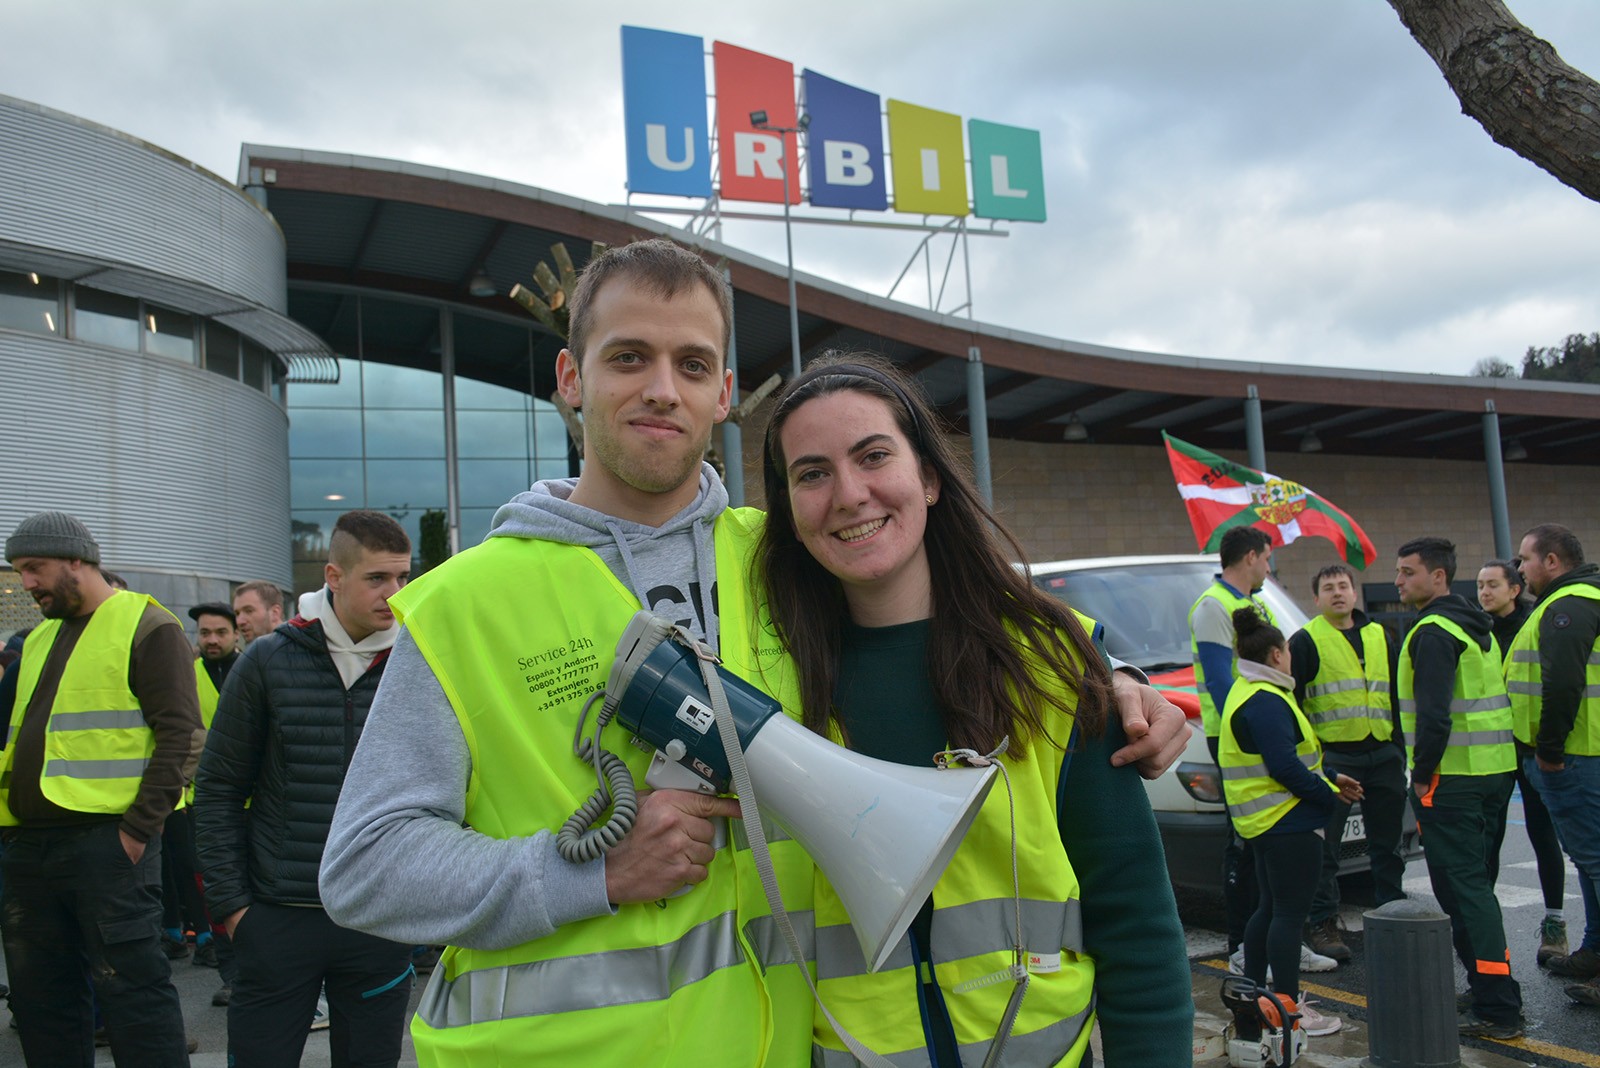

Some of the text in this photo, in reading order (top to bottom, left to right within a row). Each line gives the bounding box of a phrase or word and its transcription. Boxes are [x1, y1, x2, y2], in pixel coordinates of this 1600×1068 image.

[645, 123, 1029, 199] URBIL
[517, 637, 594, 671] Service 24h
[526, 654, 597, 683] España y Andorra
[529, 678, 555, 693] 00800
[562, 669, 578, 681] 777
[579, 662, 599, 675] 7777
[546, 677, 590, 698] Extranjero
[537, 681, 606, 712] +34 91 375 30 67
[1030, 956, 1041, 964] 3M
